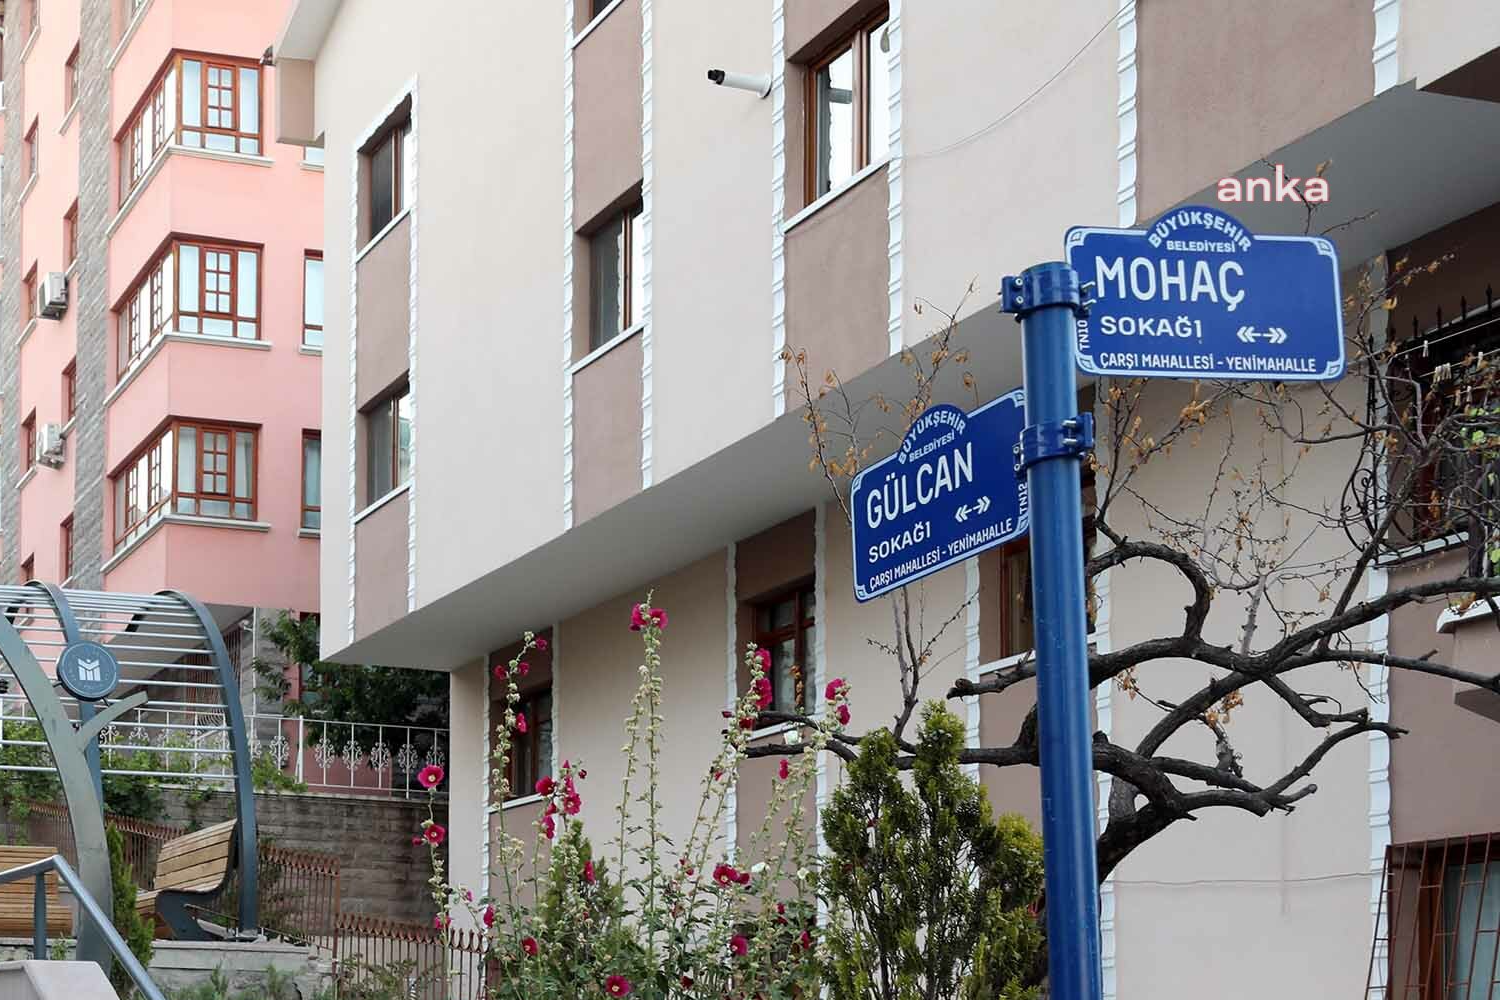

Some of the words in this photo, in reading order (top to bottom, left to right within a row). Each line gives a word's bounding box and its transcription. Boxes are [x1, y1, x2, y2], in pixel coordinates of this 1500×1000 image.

[1148, 210, 1252, 251] BÜYÜKŞEHİR
[1166, 239, 1236, 253] BELEDİYESİ
[1094, 255, 1246, 312] MOHAÇ
[1100, 315, 1202, 339] SOKAĞI
[1100, 352, 1138, 369] ÇARŞI
[1142, 353, 1214, 370] MAHALLESİ
[1225, 355, 1317, 373] YENİMAHALLE
[898, 410, 966, 465] BÜYÜKŞEHİR
[866, 442, 973, 529] GÜLCAN
[868, 520, 932, 563] SOKAĞI
[870, 569, 893, 590] ÇARŞI
[894, 545, 941, 579] MAHALLESİ
[947, 518, 1013, 556] YENİMAHALLE
